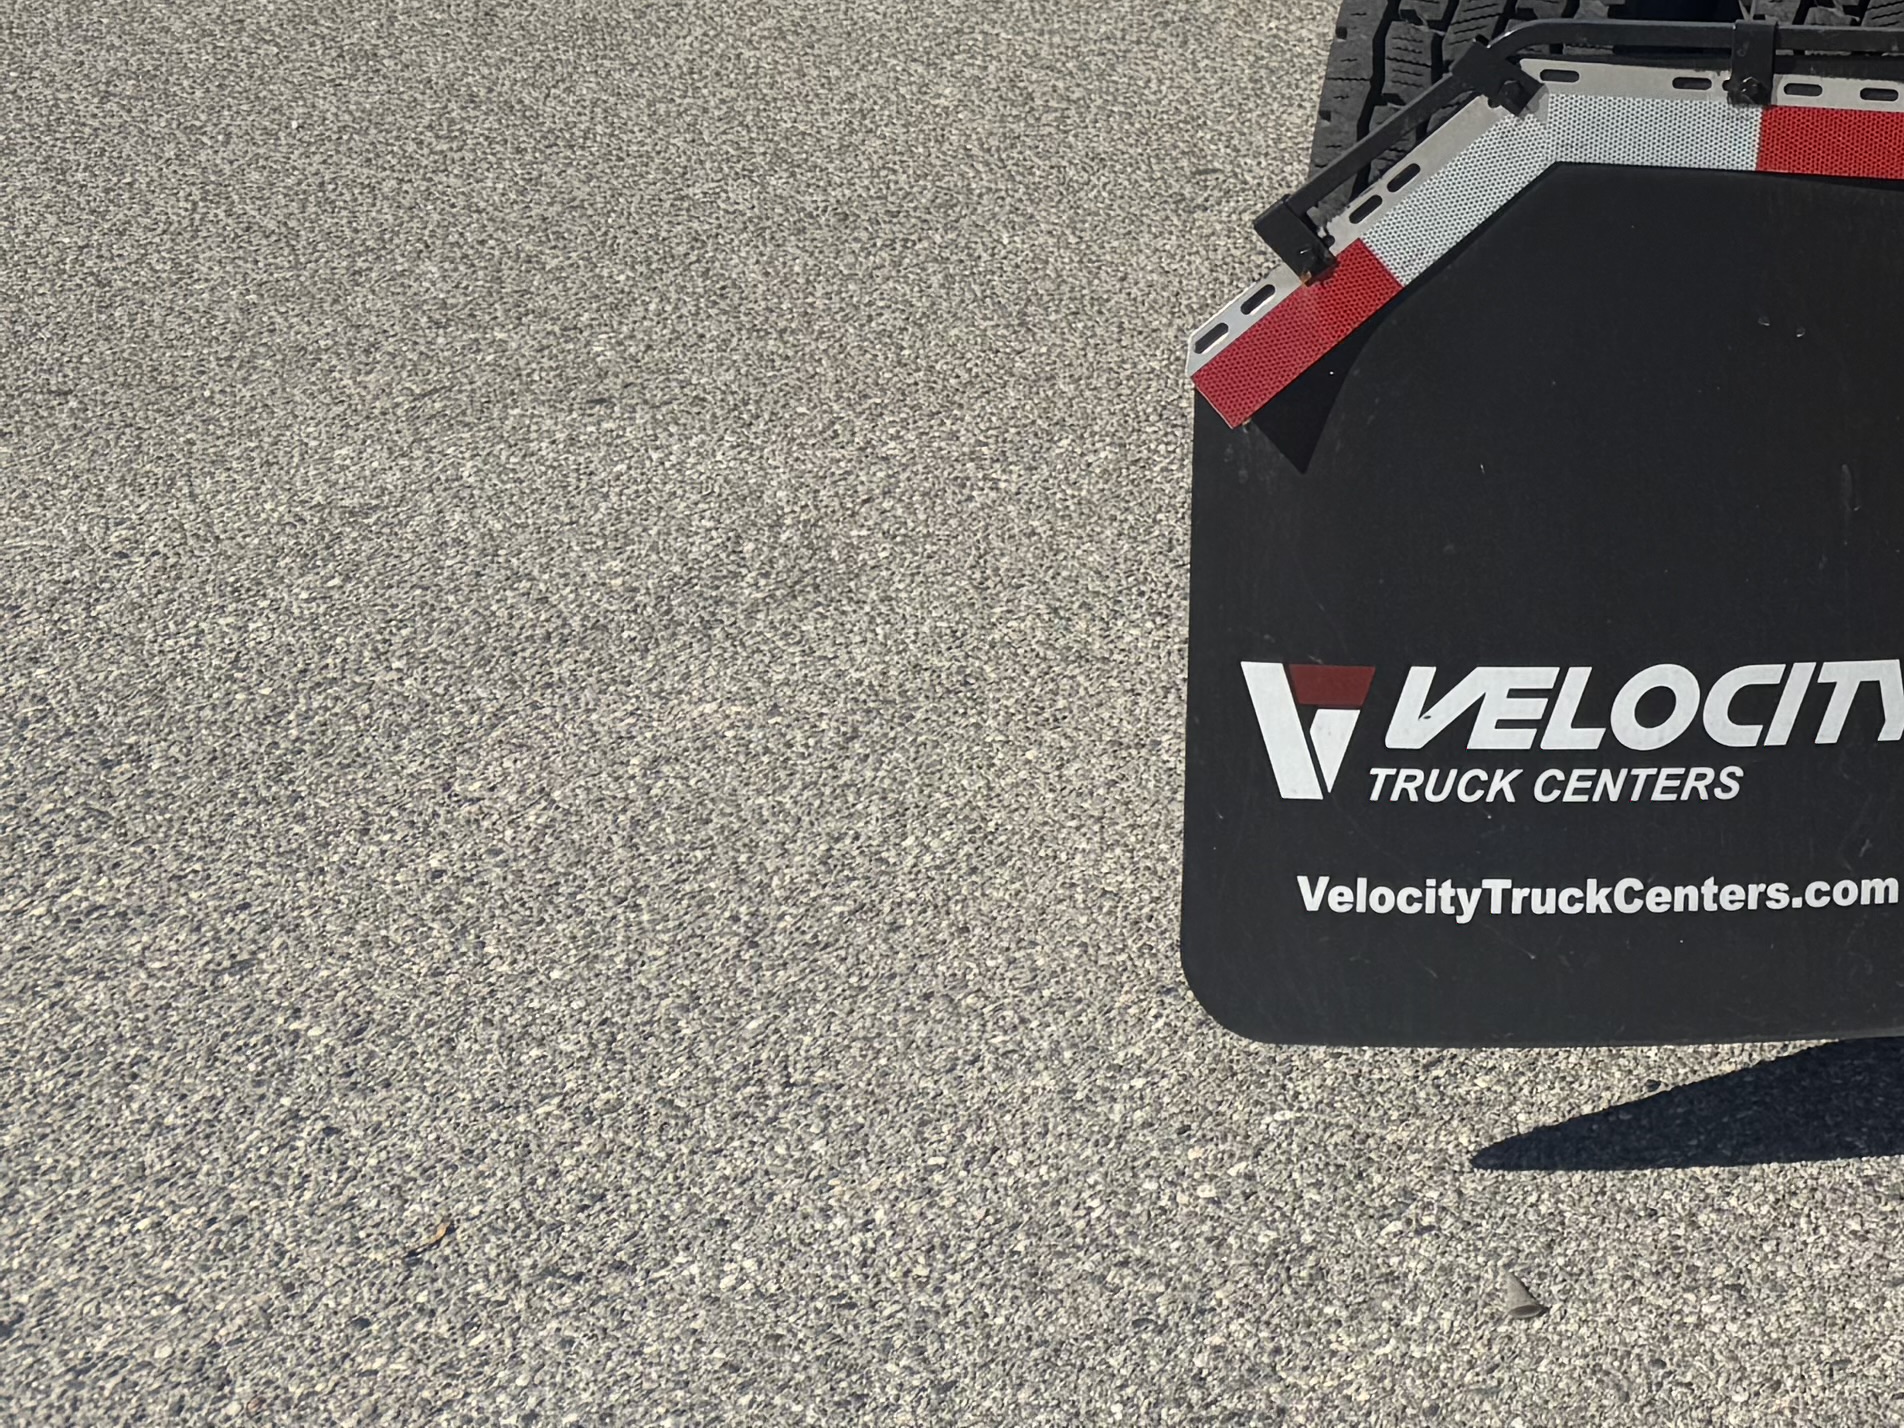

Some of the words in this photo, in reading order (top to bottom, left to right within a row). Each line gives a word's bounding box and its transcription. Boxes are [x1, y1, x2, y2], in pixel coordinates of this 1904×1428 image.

[1368, 767, 1523, 803] TRUCK
[1533, 765, 1745, 803] CENTERS
[1296, 875, 1900, 924] VelocityTruckCenters.com
